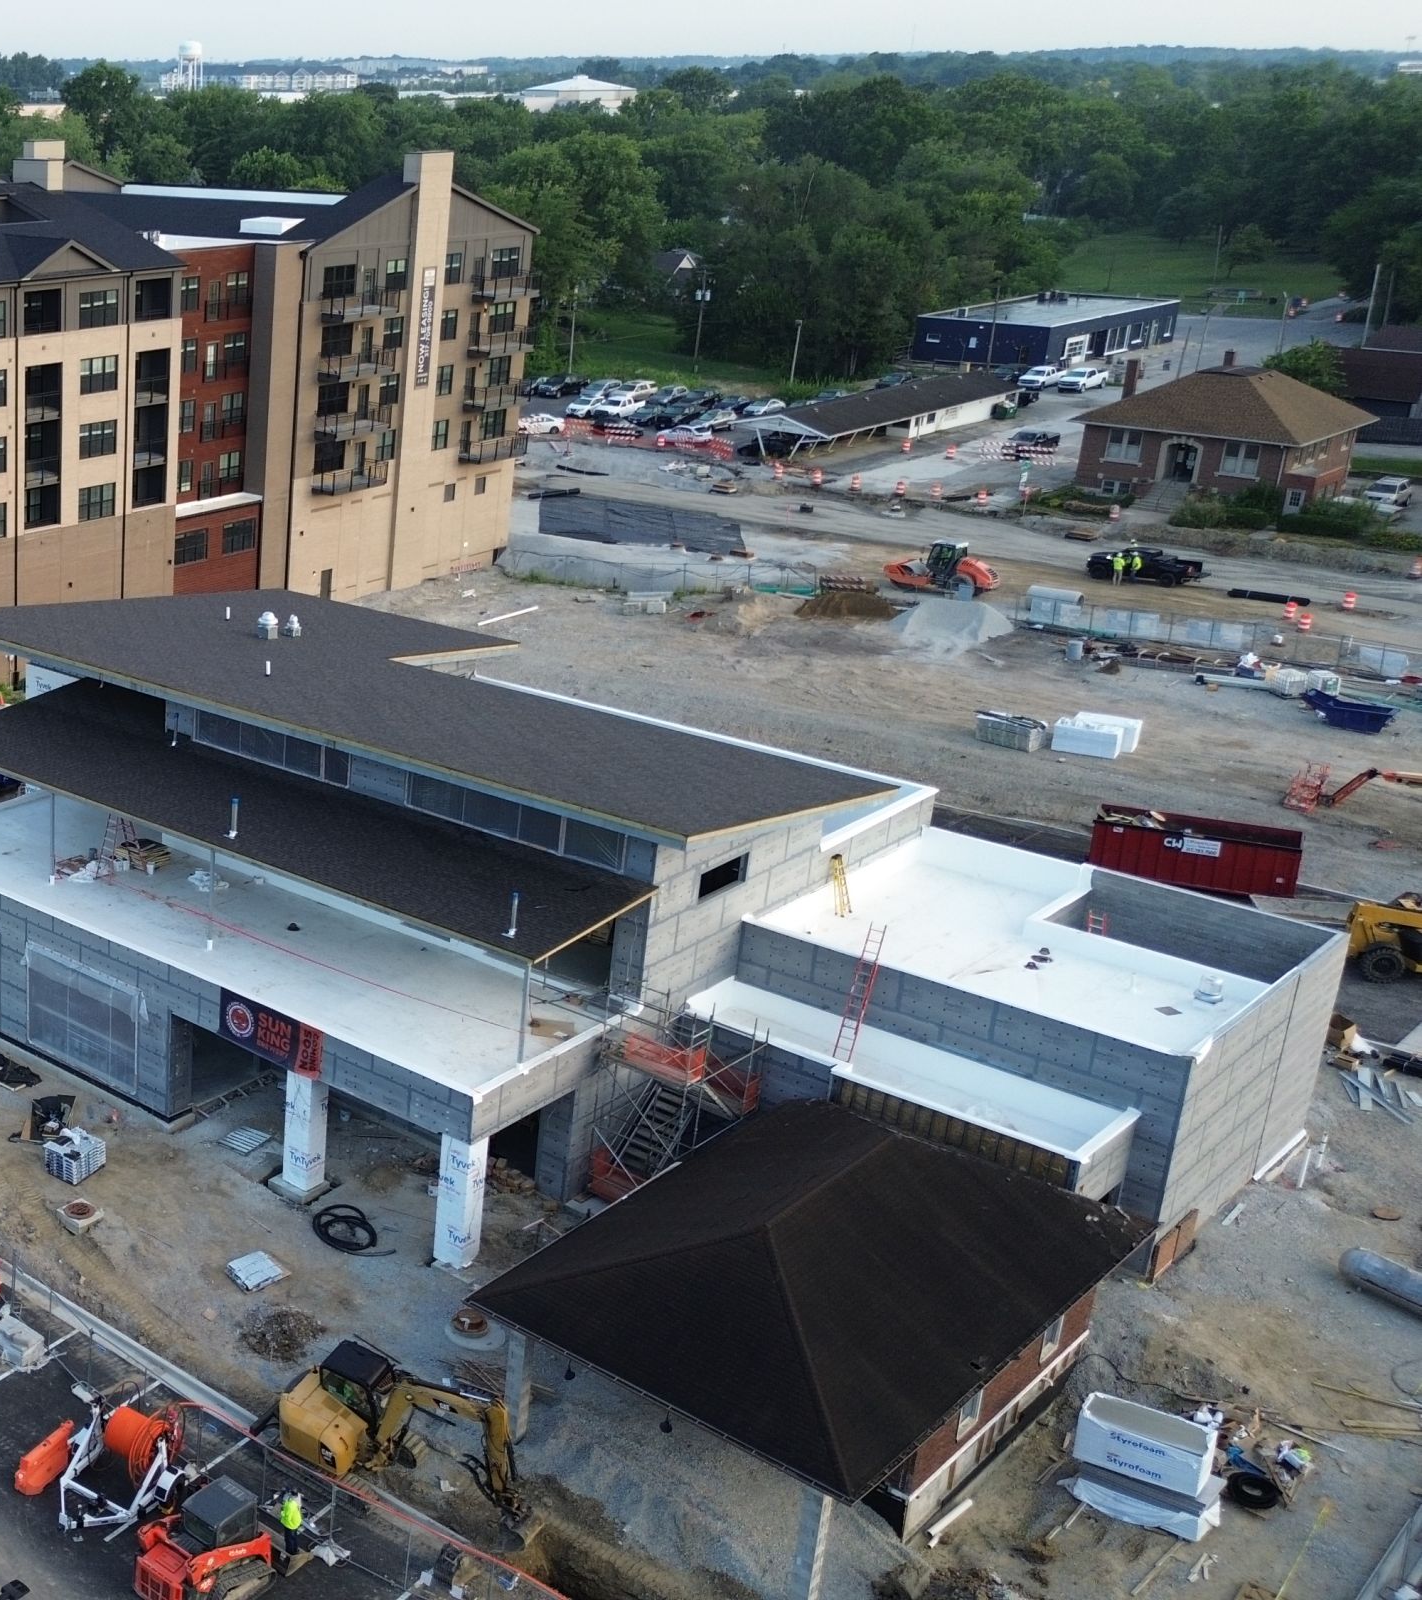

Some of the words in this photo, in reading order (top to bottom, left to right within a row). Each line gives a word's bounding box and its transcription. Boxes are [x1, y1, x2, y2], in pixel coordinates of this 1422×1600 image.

[420, 287, 430, 340] LEASING!
[418, 344, 426, 373] NOW
[1163, 837, 1183, 849] CW
[258, 1012, 292, 1038] SUN
[257, 1027, 291, 1052] KING
[298, 1029, 312, 1070] SOON
[450, 1154, 476, 1170] Tyvek
[1109, 1431, 1166, 1457] Styrofoam
[1106, 1455, 1162, 1480] Styrofoam
